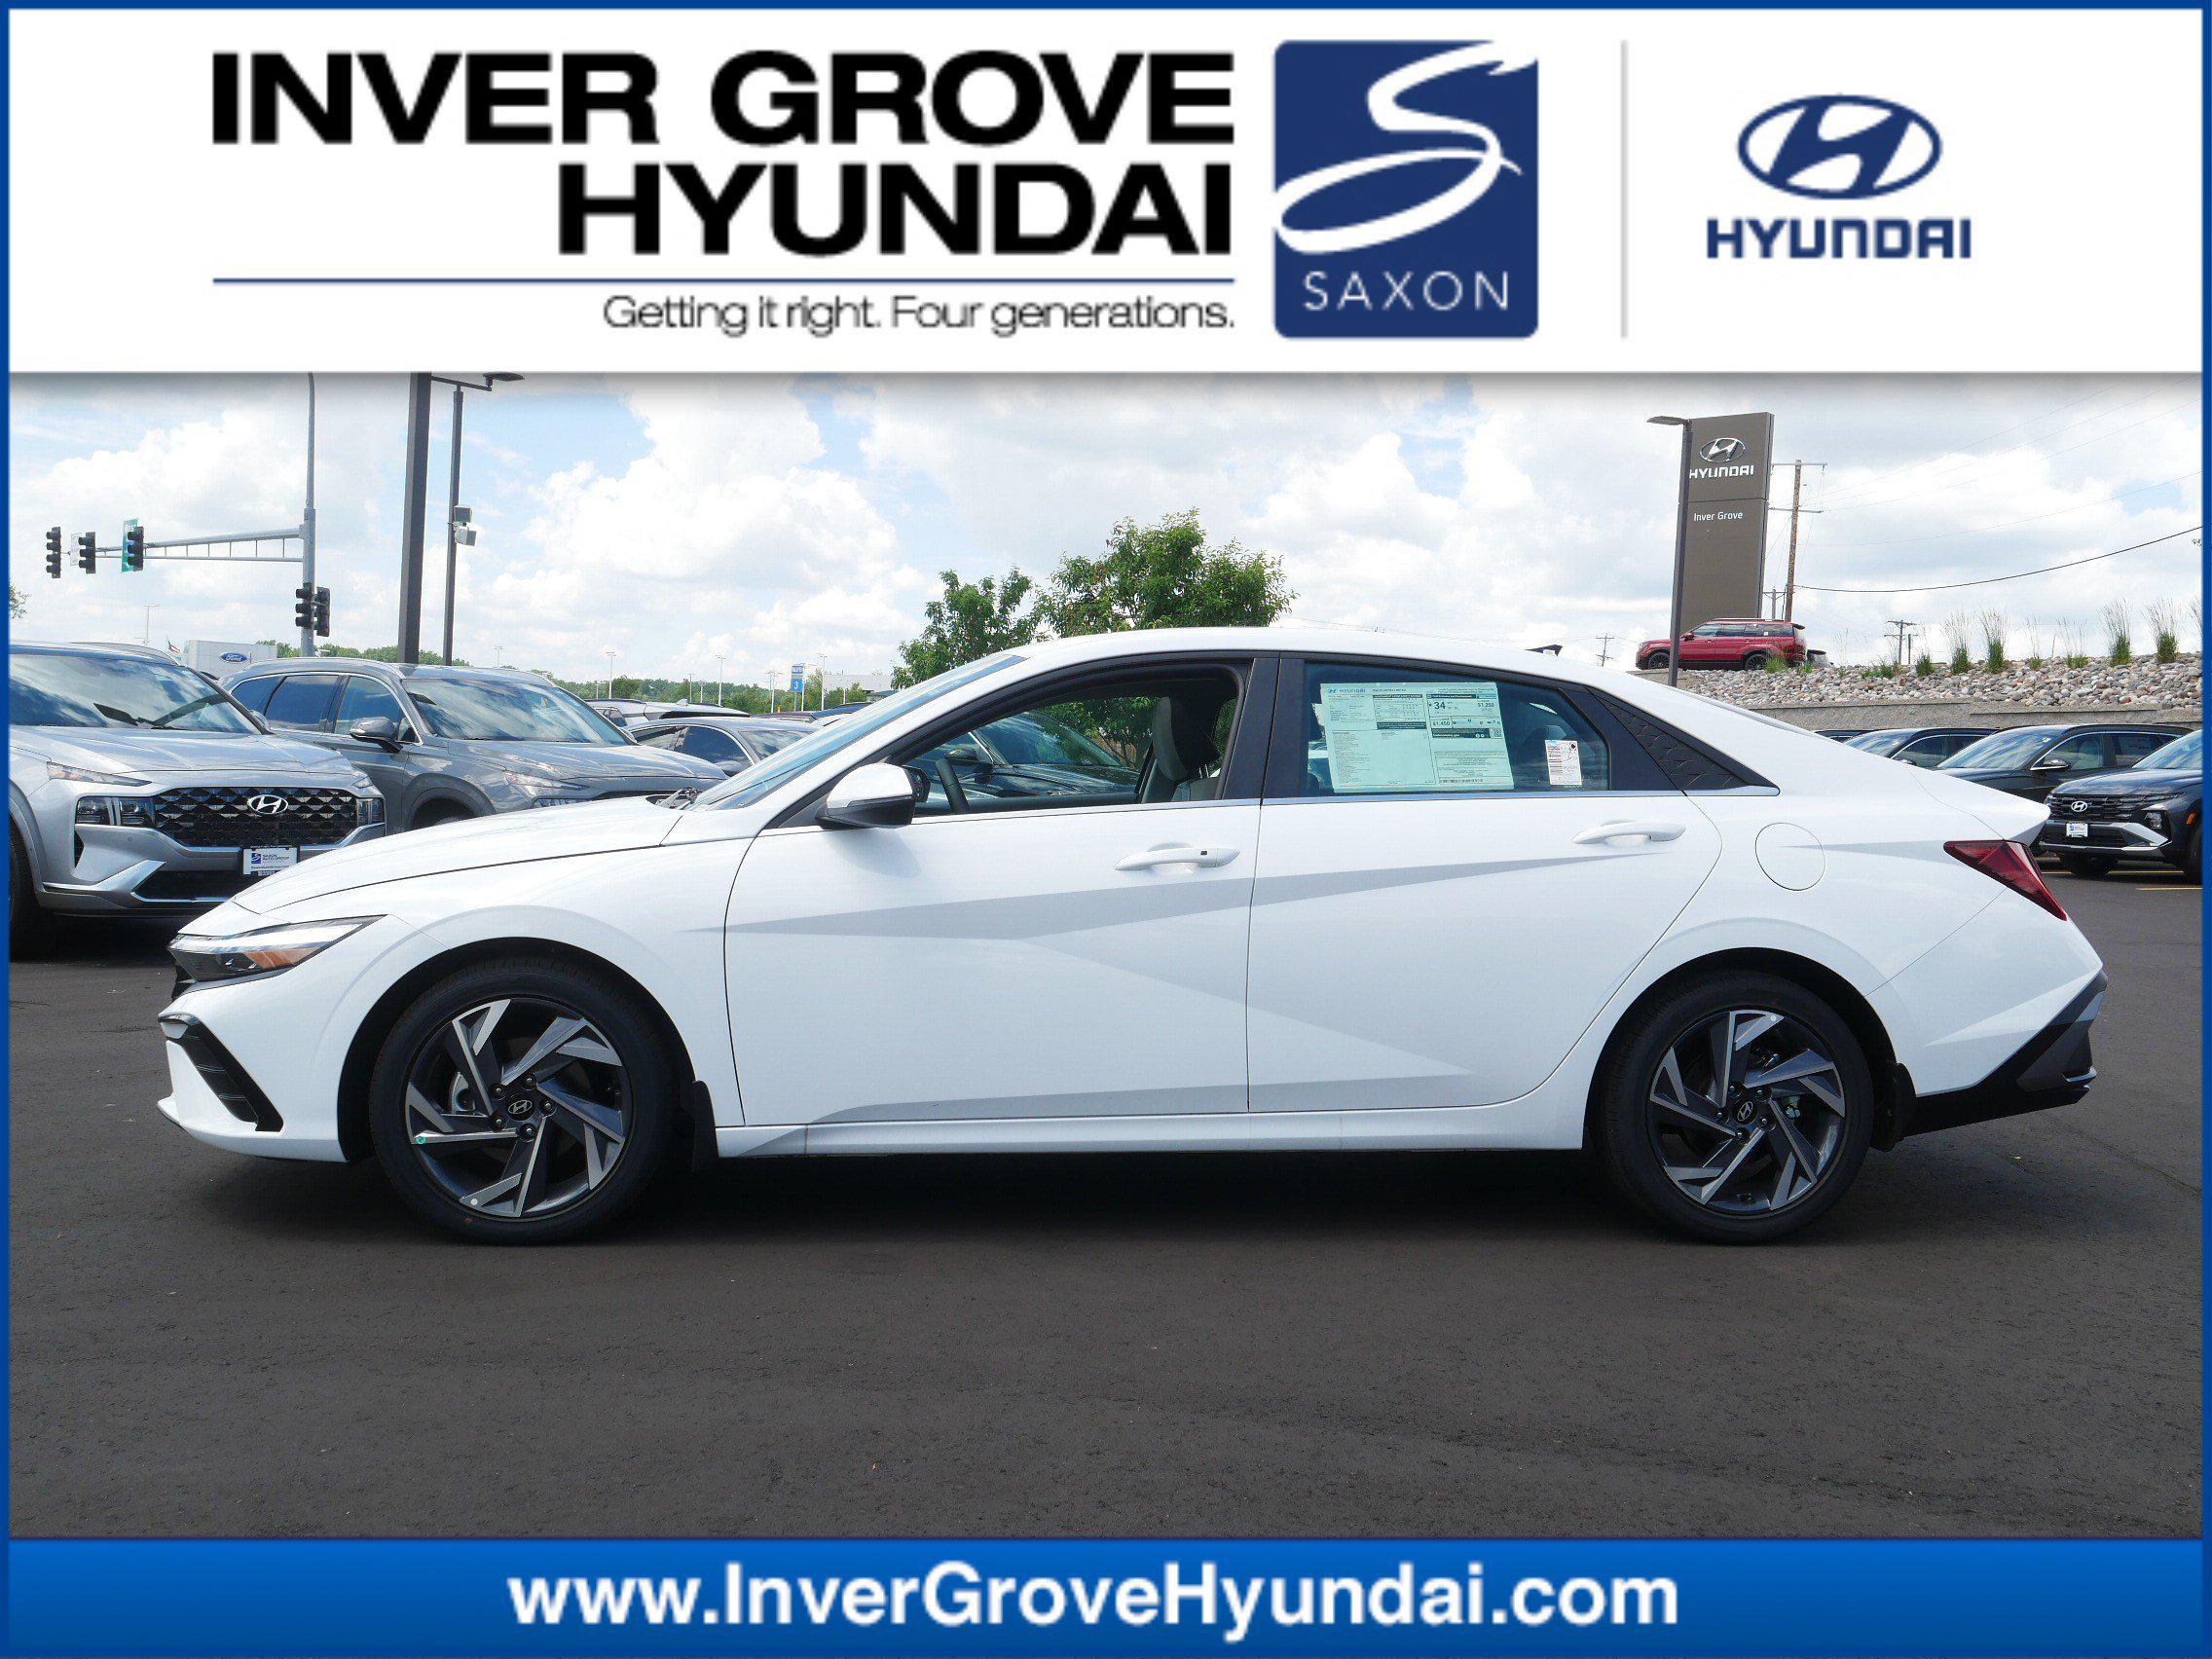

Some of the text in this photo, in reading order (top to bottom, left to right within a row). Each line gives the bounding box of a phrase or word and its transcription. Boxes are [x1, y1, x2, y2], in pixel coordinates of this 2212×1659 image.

[1689, 465, 1754, 479] HYUNDAI
[1694, 511, 1744, 521] Inver Grove
[1433, 701, 1446, 710] 34
